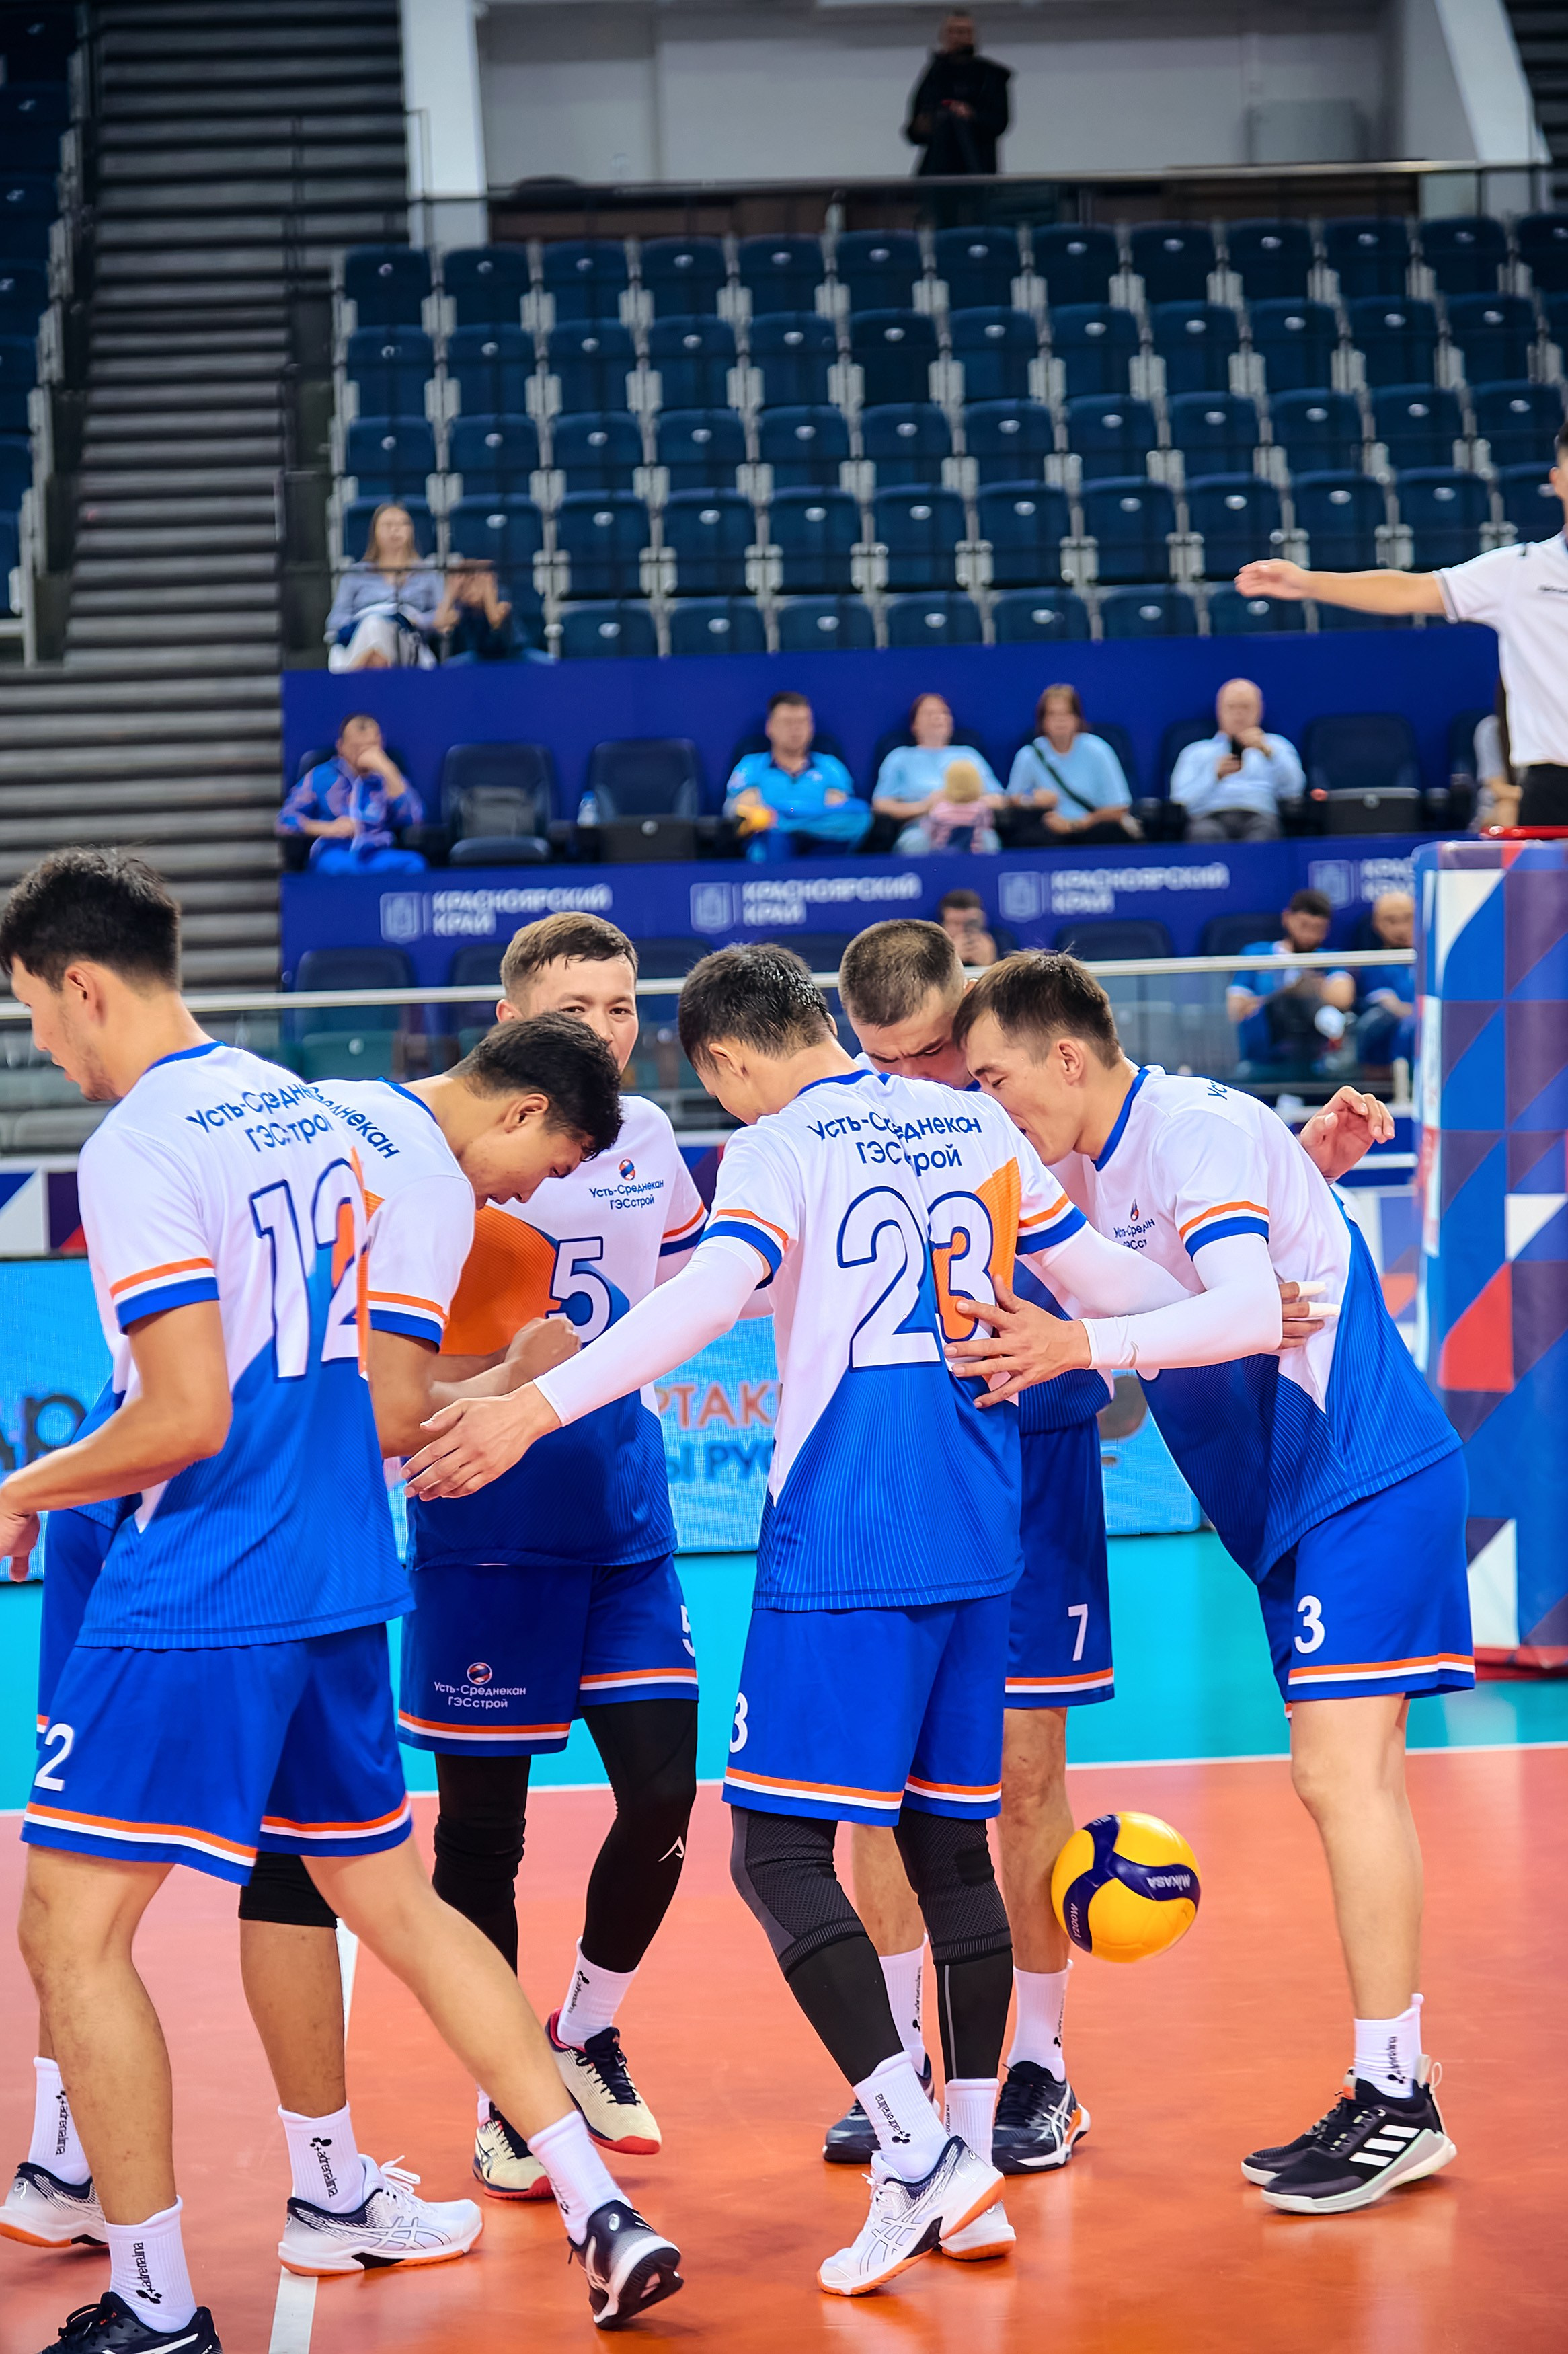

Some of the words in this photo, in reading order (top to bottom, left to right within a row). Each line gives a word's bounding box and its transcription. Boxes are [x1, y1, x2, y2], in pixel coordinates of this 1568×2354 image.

[742, 873, 921, 903] КРАСНОЯРСКИЙ
[1051, 862, 1229, 891] КРАСНОЯРСКИЙ
[432, 884, 613, 913] КРАСНОЯРСКИЙ
[1052, 890, 1115, 915] КРАЙ
[432, 911, 496, 936] КРАЙ
[742, 901, 806, 926] КРАЙ
[589, 1180, 664, 1199] Усть-Среднекан
[610, 1194, 655, 1209] ГЭСстрой
[248, 1157, 371, 1383] 12
[836, 1186, 998, 1372] 23
[545, 1236, 611, 1347] 5
[1068, 1603, 1089, 1661] 7
[1294, 1595, 1325, 1654] 3
[434, 1682, 526, 1697] Усть-Среднекан
[448, 1696, 508, 1710] ГЭСстрой
[1146, 1874, 1191, 1891] MIKASA
[1070, 1903, 1082, 1938] V200W
[132, 2242, 152, 2287] adrenalina
